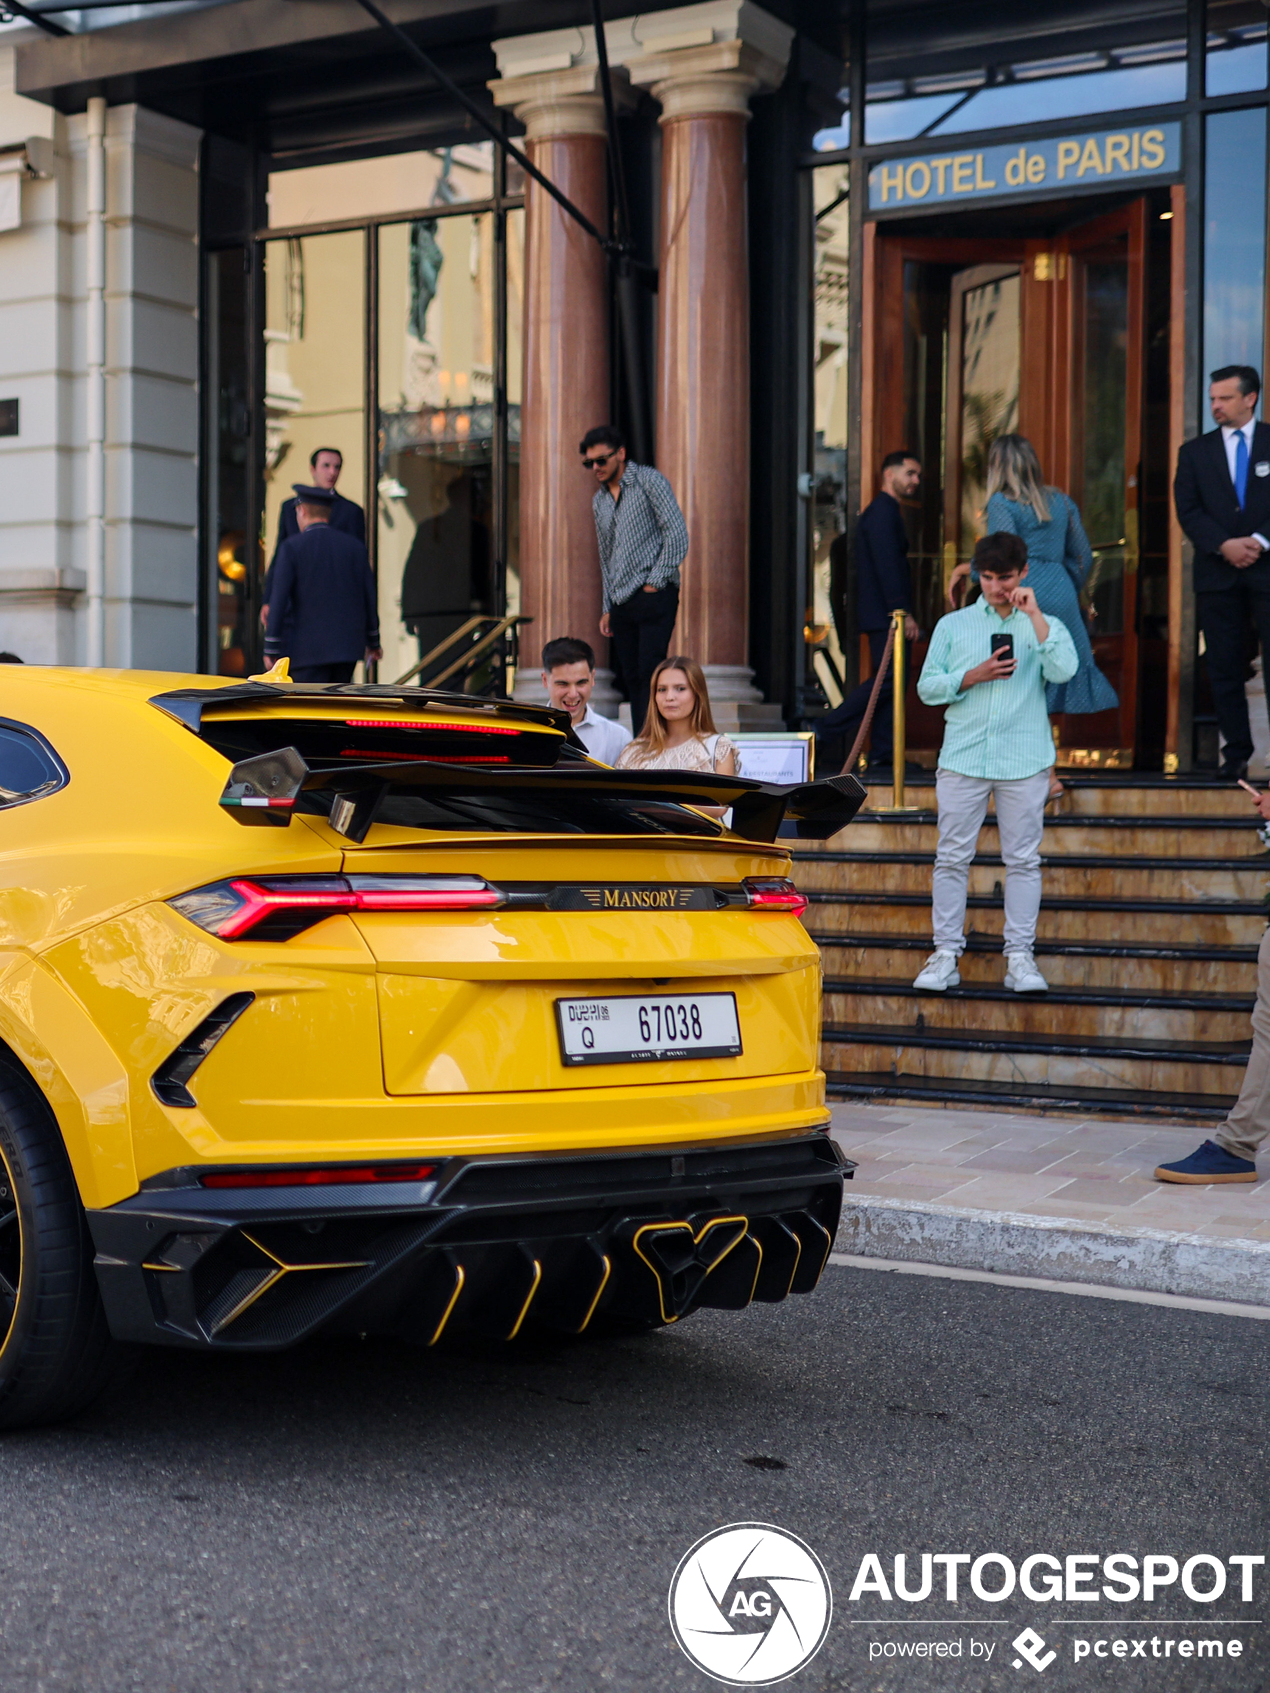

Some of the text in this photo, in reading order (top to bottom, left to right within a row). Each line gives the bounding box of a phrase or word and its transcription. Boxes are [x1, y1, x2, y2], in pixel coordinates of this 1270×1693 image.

[880, 129, 1166, 203] HOTEL de PARIS
[603, 889, 678, 908] MANSORY
[582, 1027, 595, 1049] Q
[639, 1004, 702, 1042] 67038
